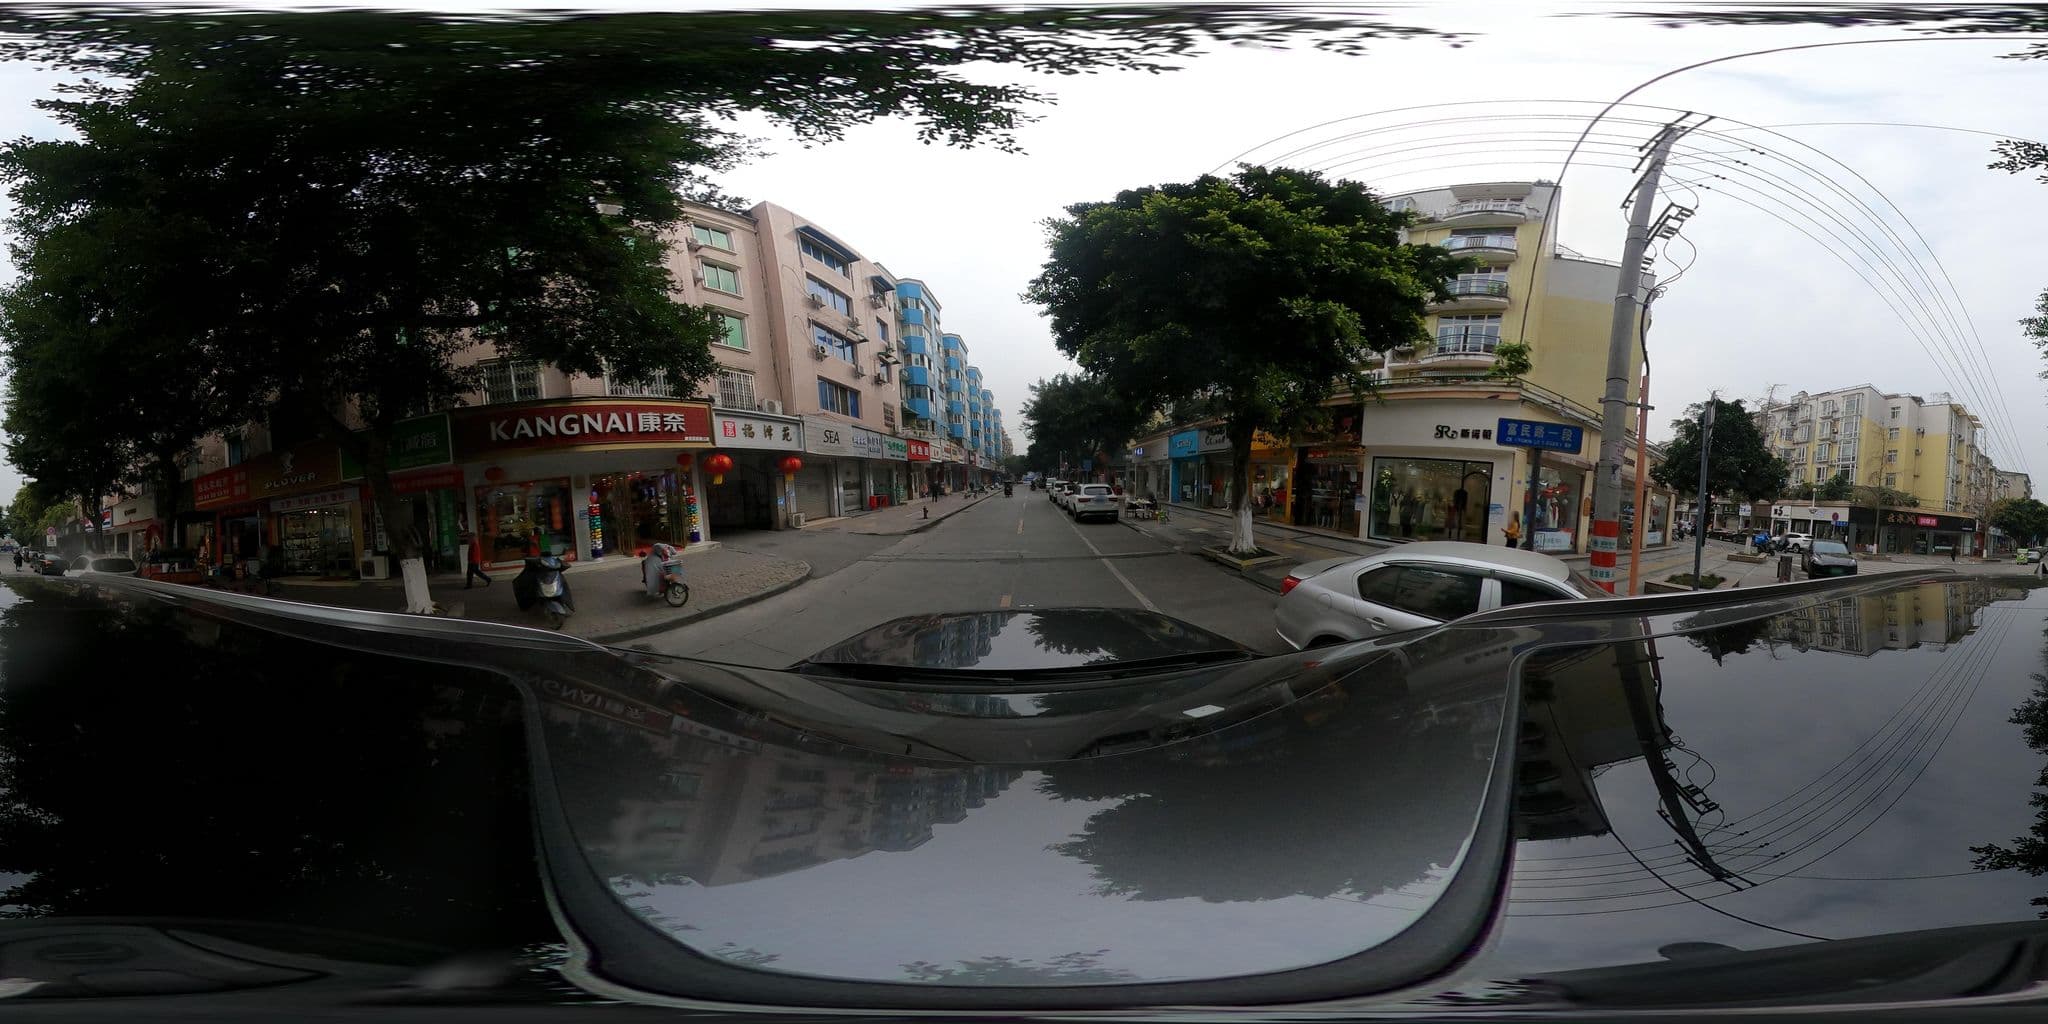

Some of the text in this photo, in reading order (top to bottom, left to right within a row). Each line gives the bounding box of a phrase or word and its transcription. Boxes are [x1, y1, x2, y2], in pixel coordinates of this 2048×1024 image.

[490, 412, 633, 441] KANGNAI
[638, 412, 686, 433] 康奈
[1506, 423, 1573, 442] 富民路一段
[823, 429, 840, 444] SEA
